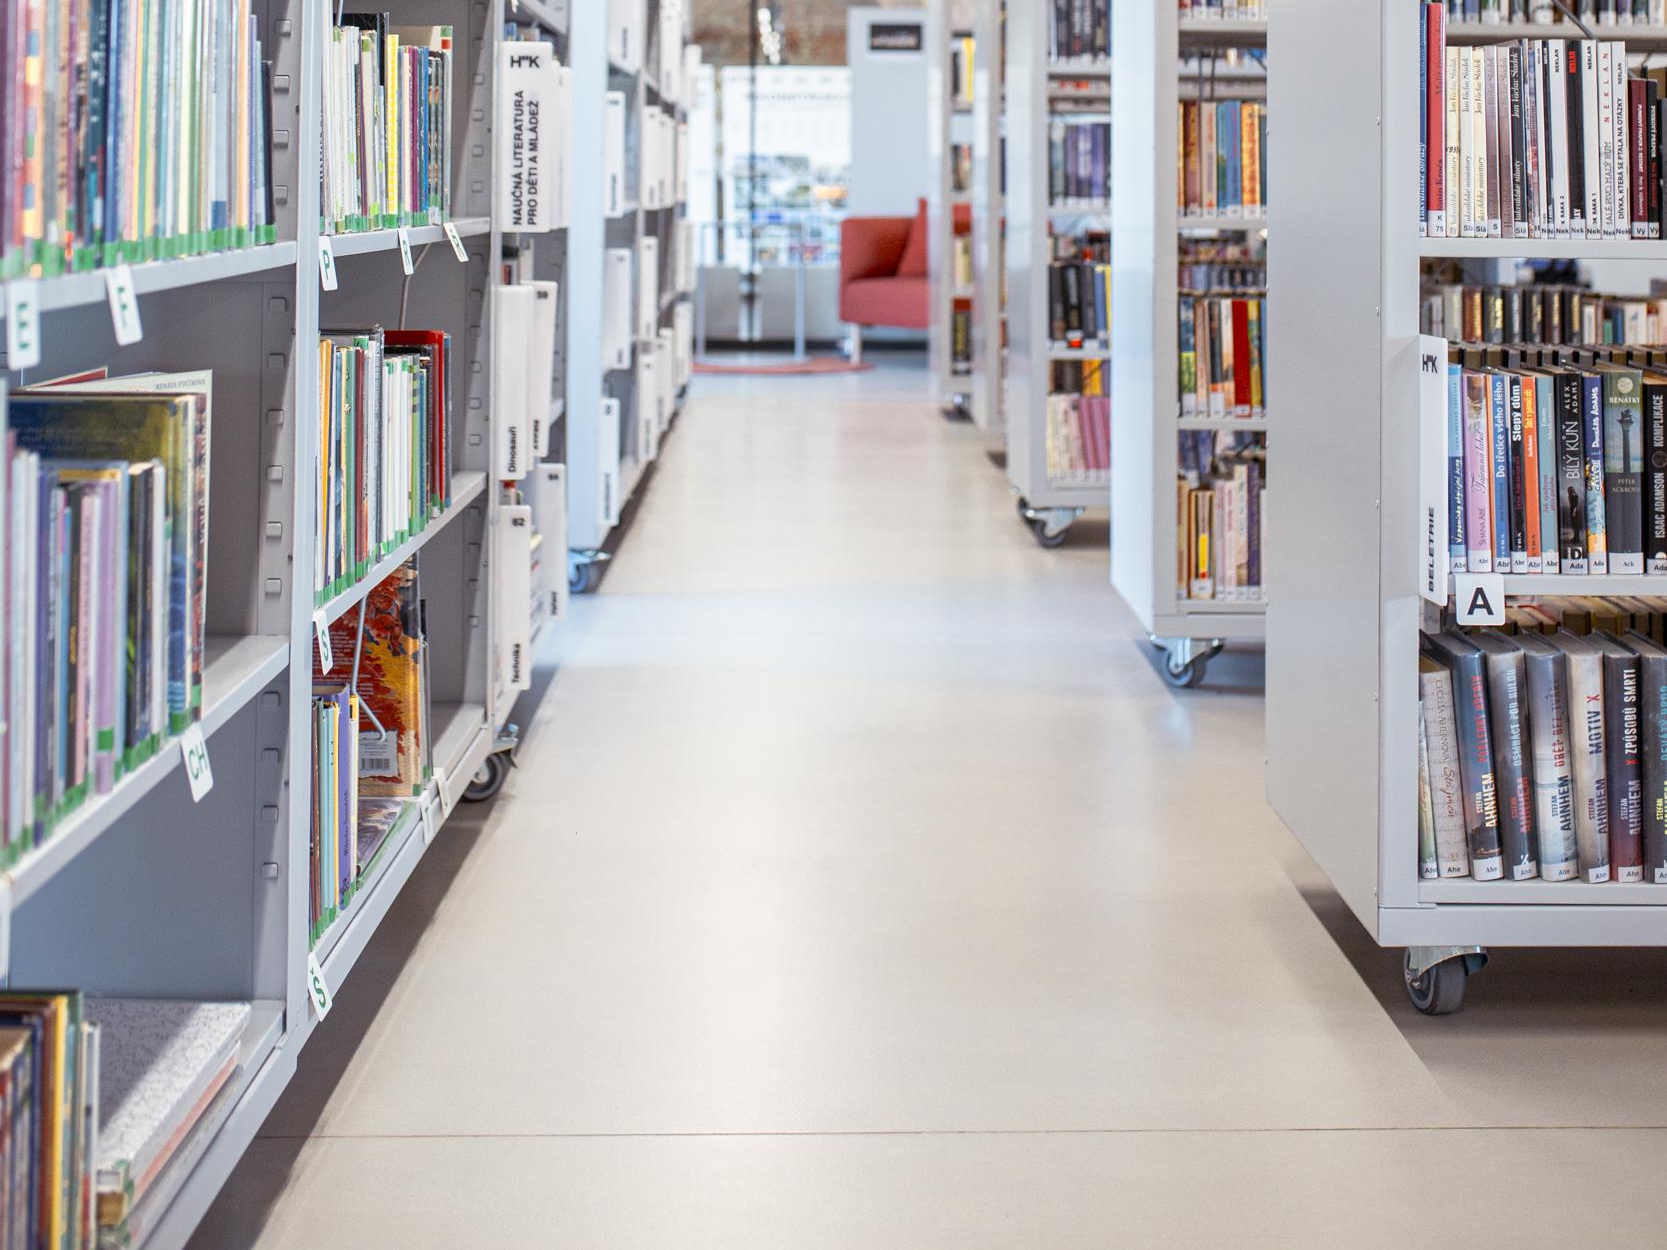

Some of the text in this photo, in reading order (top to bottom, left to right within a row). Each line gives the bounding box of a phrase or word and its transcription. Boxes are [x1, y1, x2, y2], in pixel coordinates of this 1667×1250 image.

[1616, 98, 1624, 125] OTÁZKY
[1616, 126, 1624, 137] NA
[512, 90, 524, 226] NAUČNÁ LITERATURA
[525, 100, 539, 226] PRO DĚTI A MLÁDEŽ
[1616, 138, 1624, 160] PTALA
[1603, 161, 1612, 184] MALÝ
[1616, 161, 1624, 170] SE
[1616, 172, 1624, 194] KTERÁ
[1555, 227, 1568, 235] Nek
[1636, 227, 1646, 236] Vý
[322, 249, 331, 281] P
[1512, 384, 1522, 441] Slepý dům
[1591, 387, 1599, 416] ADAMS
[1495, 381, 1506, 478] Do třetice všeho zlého
[508, 425, 517, 473] Dinosauři
[1562, 421, 1579, 479] BÍLÝ KŮŇ
[1617, 478, 1636, 486] PETER
[1652, 394, 1666, 538] ISAAC ADAMSON KOMPLIKACE
[512, 518, 525, 527] 62
[1478, 522, 1487, 546] SHANA
[1427, 506, 1435, 592] BELETRIE
[1466, 586, 1495, 616] A
[321, 629, 329, 662] S
[511, 643, 521, 684] Technika
[1623, 669, 1636, 702] SMRTI
[1509, 701, 1519, 720] POD
[1553, 717, 1563, 735] BEZ
[1587, 693, 1602, 755] MOTIV X
[1621, 707, 1638, 754] ZPŮSOBŮ
[188, 739, 208, 780] CH
[1475, 791, 1484, 814] STEFAN
[1482, 772, 1498, 828] AHNHEM
[1558, 775, 1571, 831] AHNHEM
[1595, 778, 1608, 835] AHNHEM
[1620, 797, 1628, 820] STEFAN
[1628, 780, 1642, 835] AHNHEM
[1656, 797, 1664, 820] STEFAN
[309, 967, 327, 1009] Š
